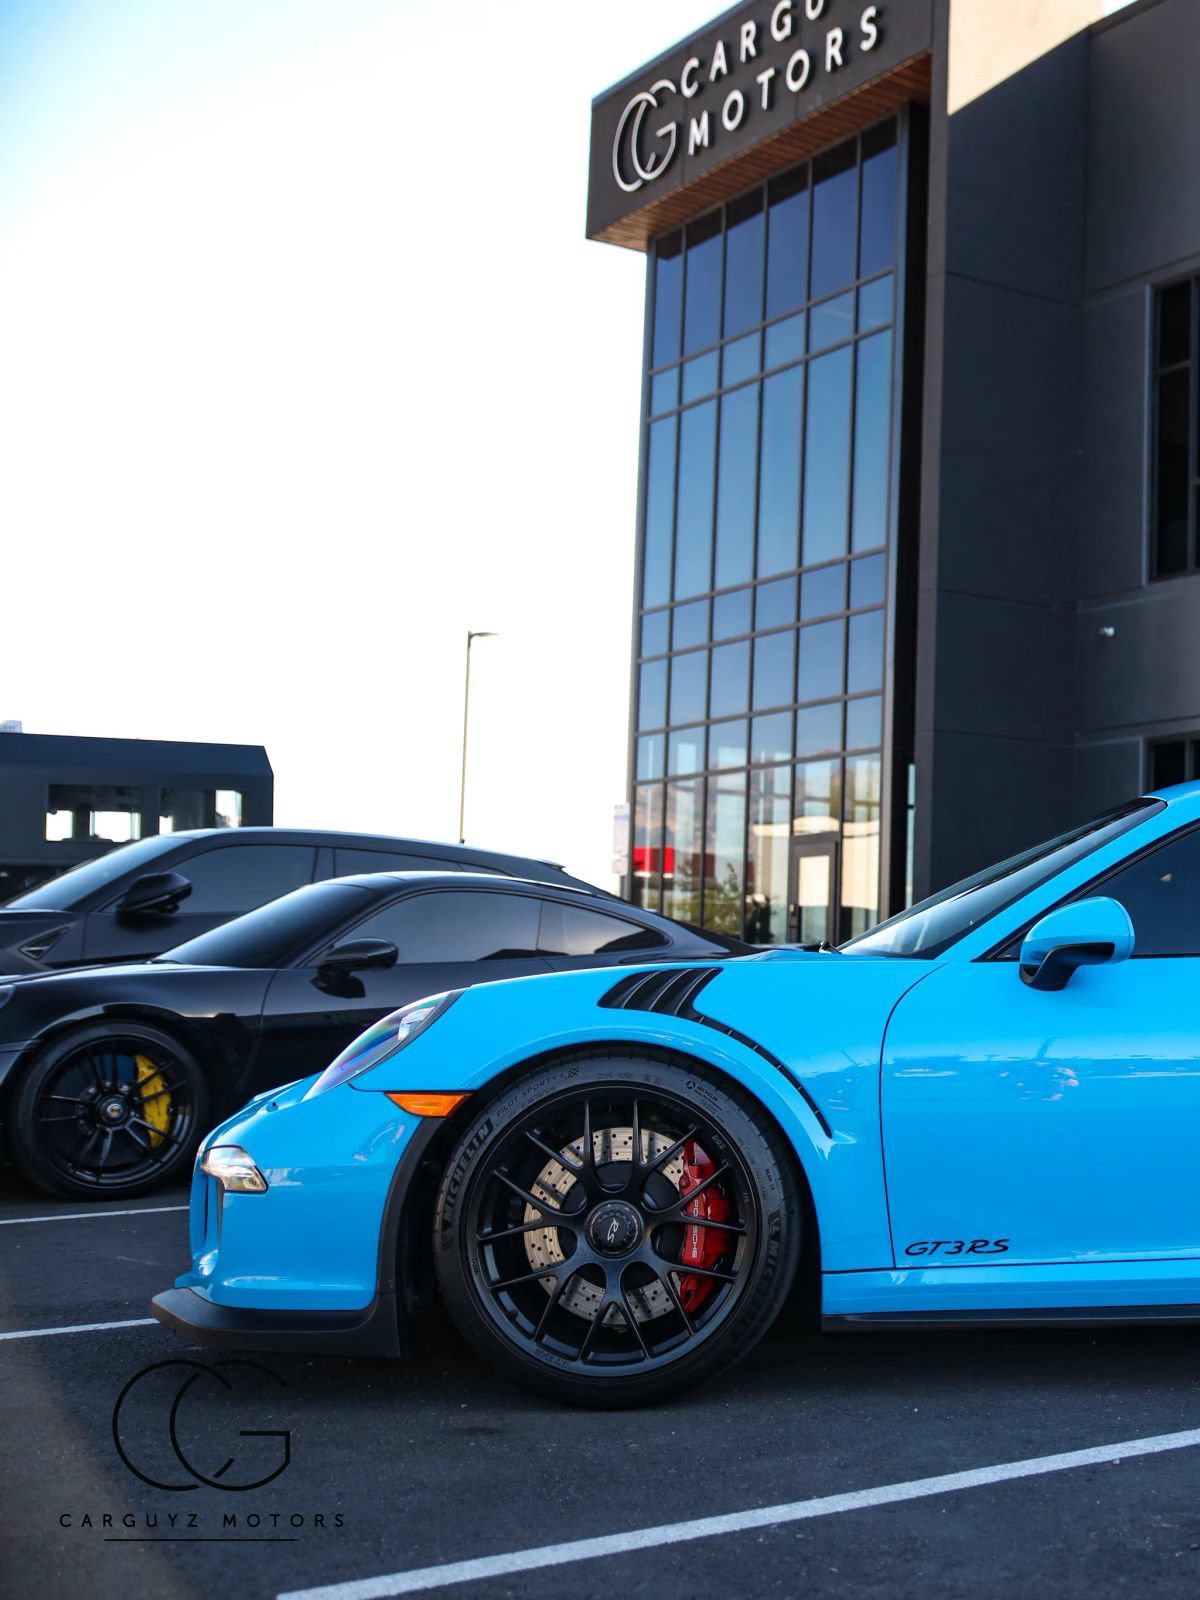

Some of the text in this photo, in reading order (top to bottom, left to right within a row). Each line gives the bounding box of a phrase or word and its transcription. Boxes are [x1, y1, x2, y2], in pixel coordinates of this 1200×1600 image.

[687, 5, 878, 156] MOTORS
[496, 1096, 518, 1118] PILOT
[521, 1079, 551, 1097] SPORT
[443, 1123, 490, 1221] MICHELIN
[691, 1199, 699, 1259] POSCHE
